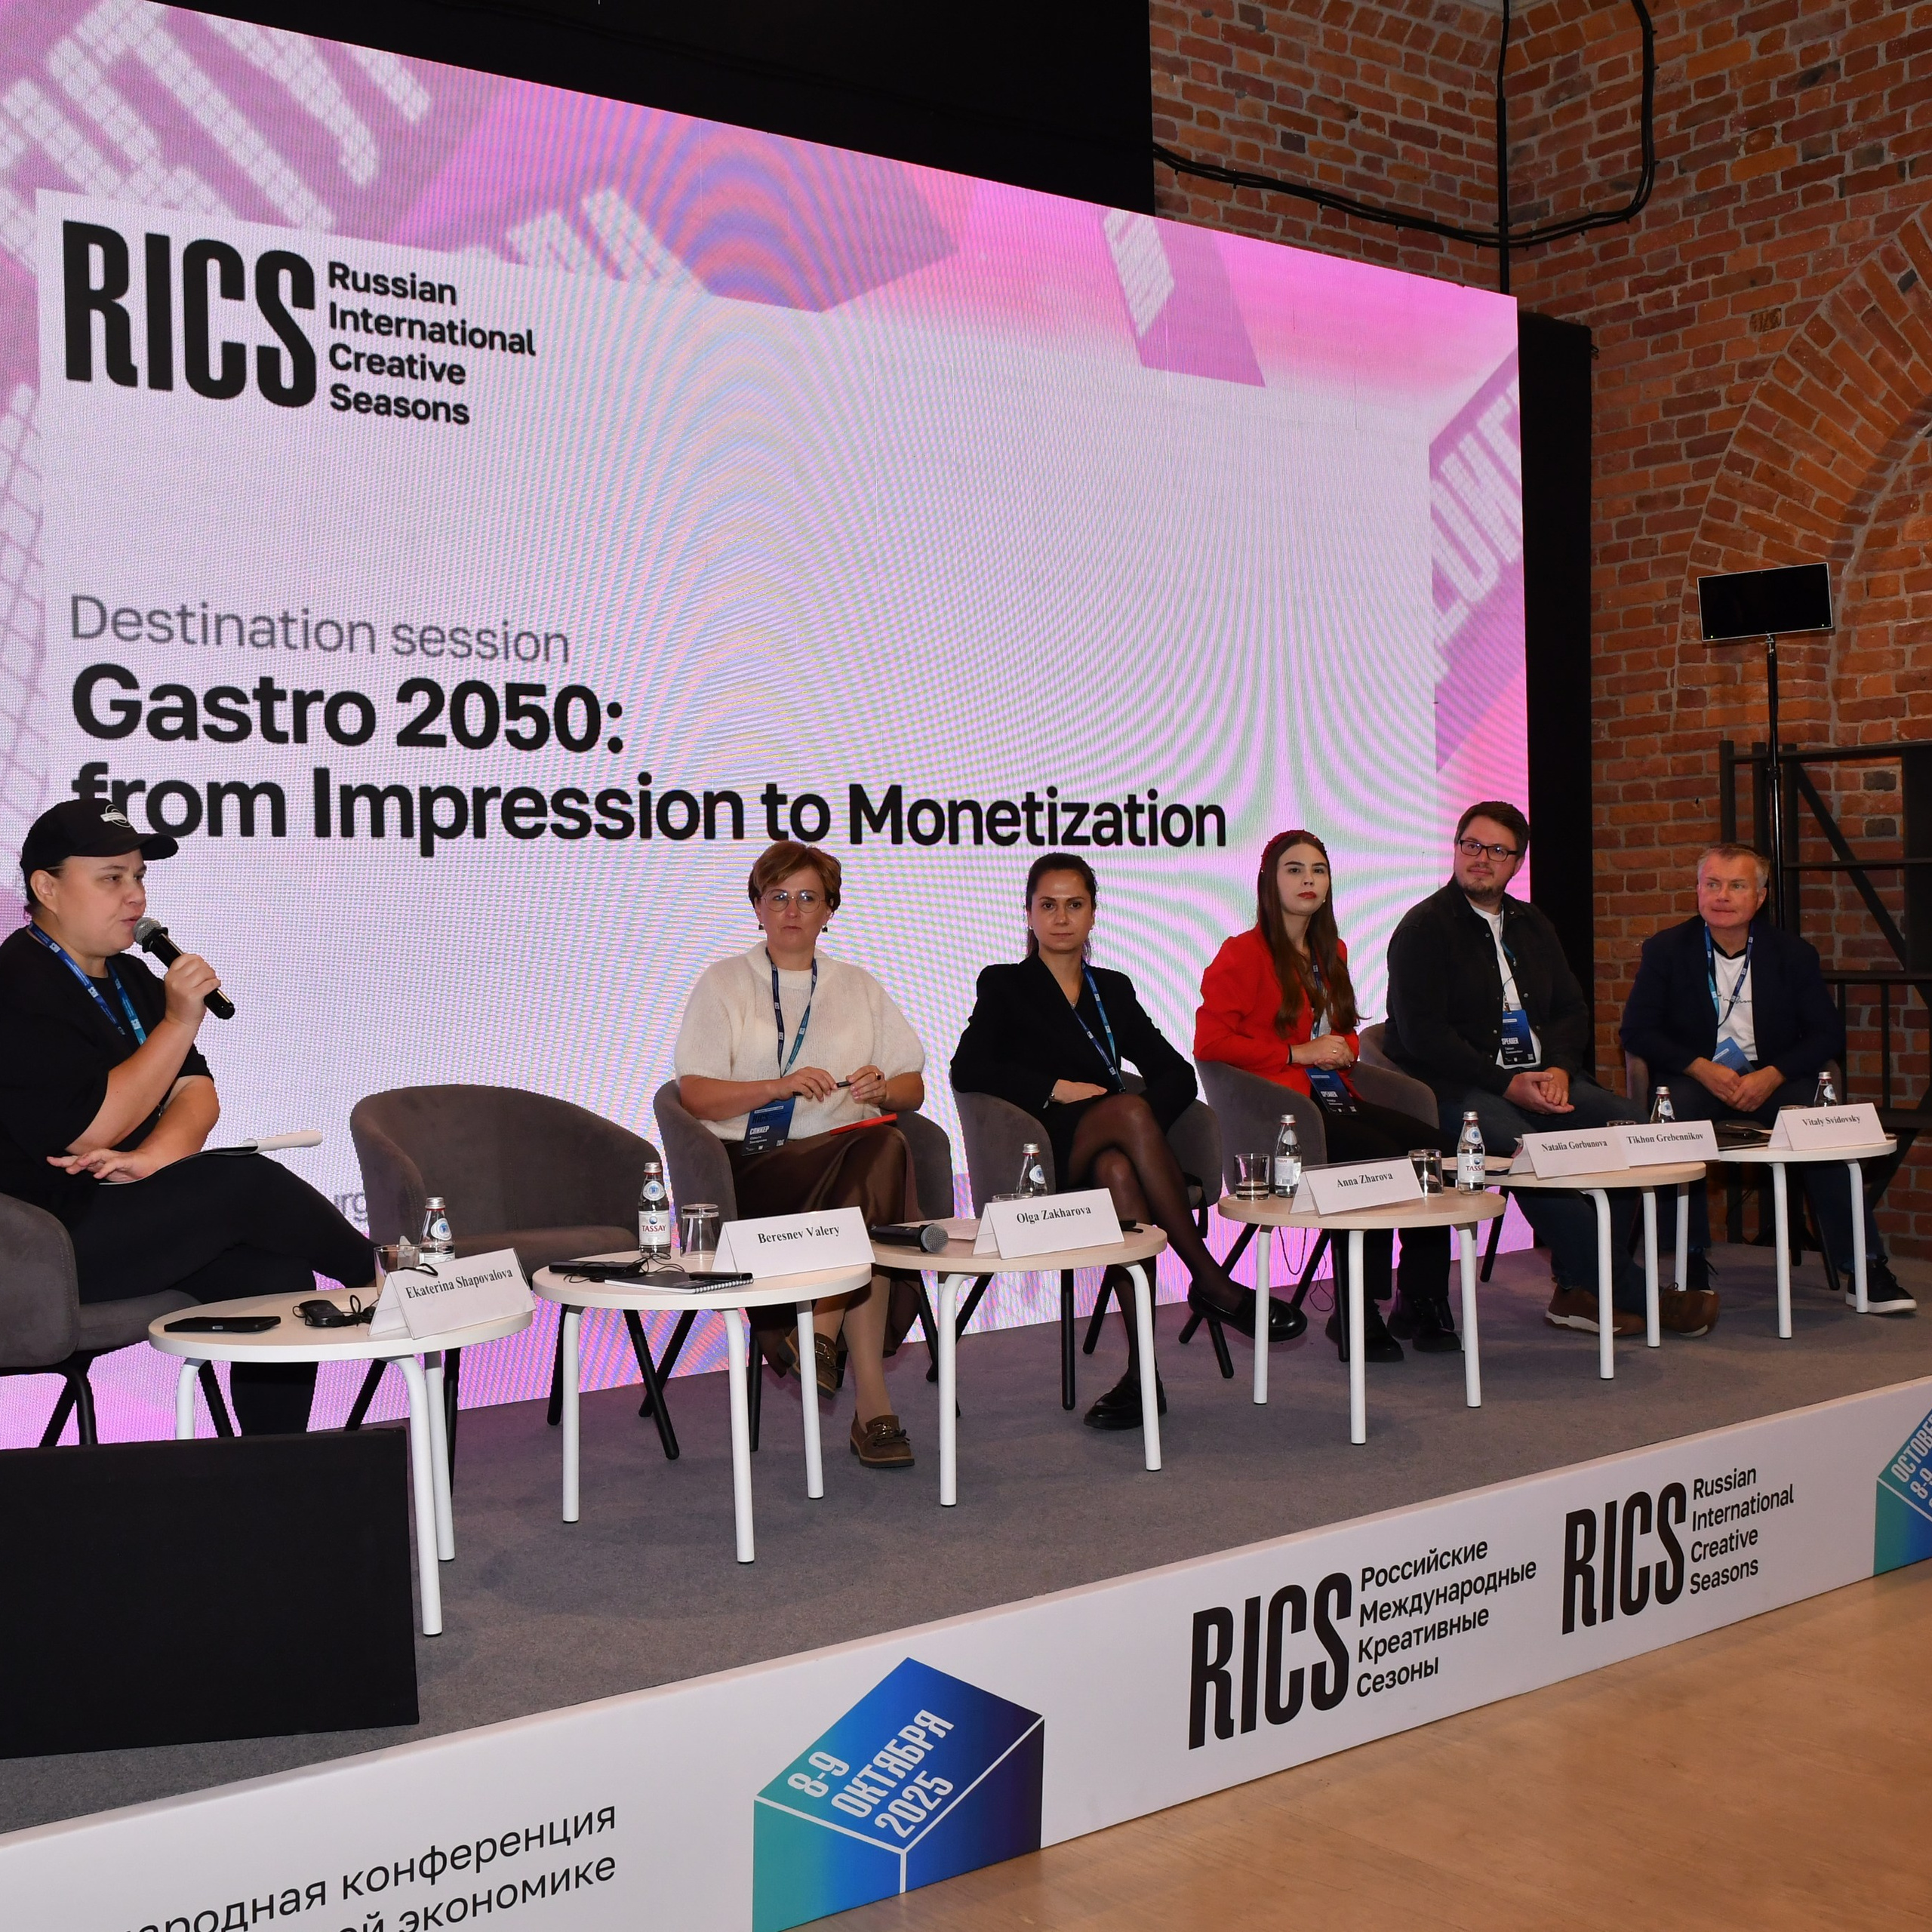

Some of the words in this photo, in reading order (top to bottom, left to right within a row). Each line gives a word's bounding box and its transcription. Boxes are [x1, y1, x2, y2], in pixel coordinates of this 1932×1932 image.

[328, 260, 457, 306] Russian
[63, 220, 317, 408] RICS
[329, 302, 537, 356] International
[329, 343, 466, 386] Creative
[330, 383, 470, 426] Seasons
[70, 594, 377, 655] Destination
[391, 619, 571, 664] session
[72, 663, 377, 747] Gastro
[395, 677, 624, 755] 2050:
[72, 761, 287, 838] from
[313, 768, 745, 858] Impression
[760, 783, 831, 843] to
[848, 783, 1226, 848] Monetization
[1626, 1136, 1656, 1145] Tikhon
[1656, 1132, 1704, 1143] Grebennikov
[1801, 1118, 1825, 1127] Vitaly
[1825, 1115, 1861, 1124] Svidovsky
[1541, 1143, 1568, 1152] Natalia
[1568, 1140, 1608, 1150] Gorbunova
[1337, 1178, 1359, 1188] Anna
[1359, 1173, 1394, 1184] Zharova
[641, 1224, 667, 1232] TASSAY
[757, 1231, 804, 1244] Beresnev
[806, 1226, 840, 1237] Valery
[1016, 1212, 1040, 1224] Olga
[1041, 1206, 1092, 1220] Zakharova
[405, 1281, 455, 1299] Ekaterina
[455, 1269, 513, 1289] Shapovalova
[1890, 1414, 1932, 1483] OCTOBE
[1692, 1465, 1757, 1501] Russian
[1691, 1484, 1795, 1533] International
[1361, 1538, 1488, 1592] Российские
[1561, 1481, 1687, 1635] RICS
[1690, 1527, 1759, 1564] Creative
[1359, 1556, 1537, 1628] Международные
[1689, 1558, 1759, 1595] Seasons
[1358, 1604, 1490, 1664] Креативные
[1188, 1572, 1352, 1750] RICS
[1356, 1656, 1440, 1699] Сезоны
[787, 1751, 850, 1798] 8-9
[831, 1709, 955, 1818] ОКТЯБРЯ
[874, 1770, 954, 1838] 2025
[125, 1880, 327, 1932] одная
[343, 1805, 616, 1900] конференция
[398, 1857, 616, 1932] экономике
